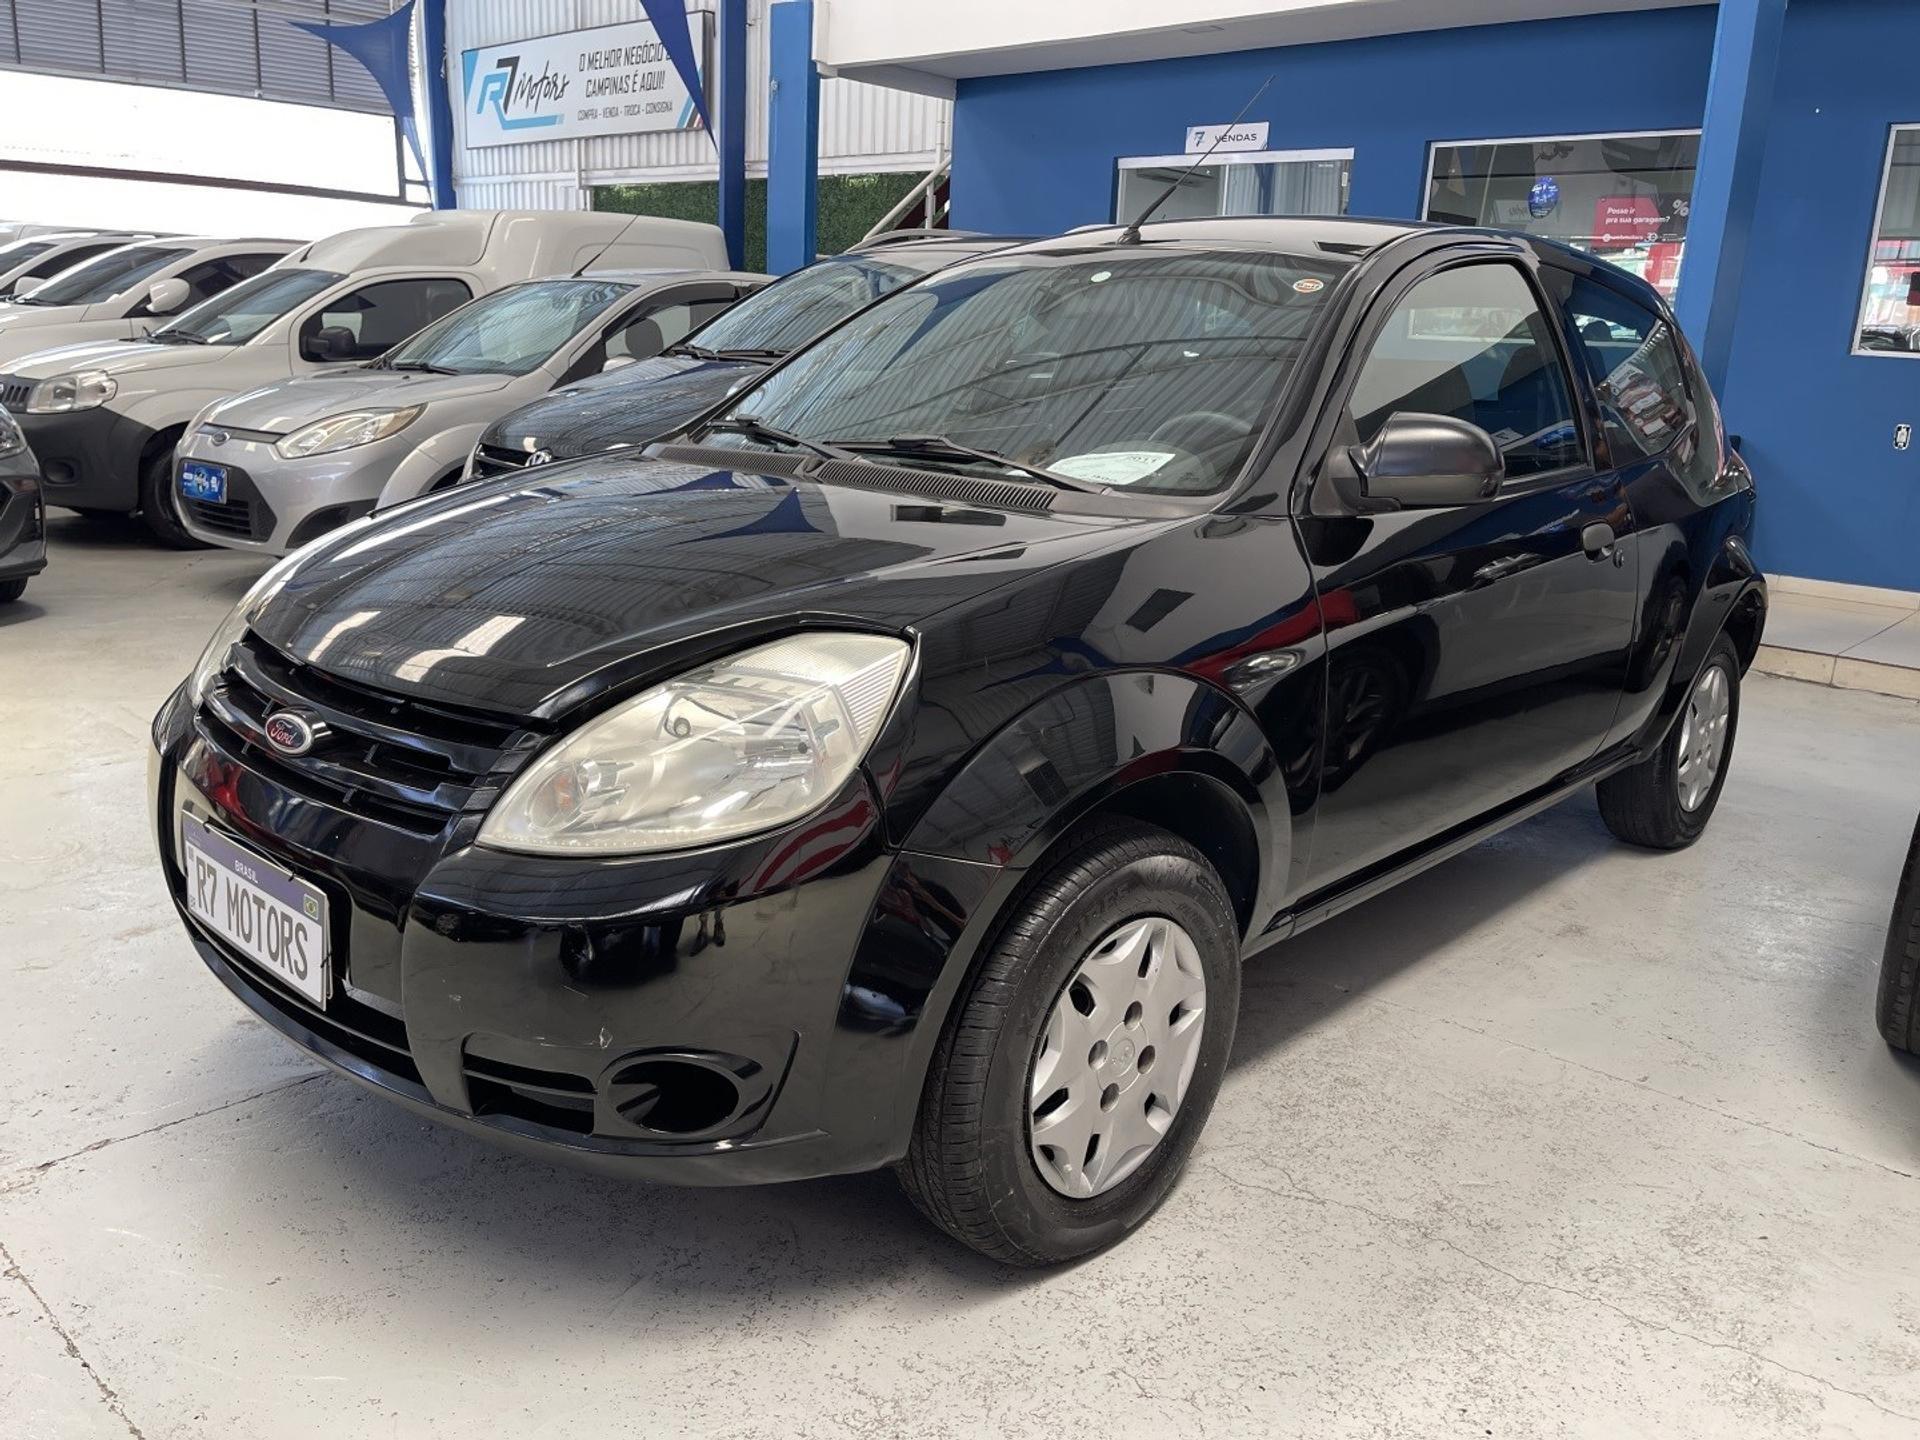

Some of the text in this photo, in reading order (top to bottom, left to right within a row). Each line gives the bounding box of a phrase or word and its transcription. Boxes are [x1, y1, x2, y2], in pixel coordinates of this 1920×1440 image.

[578, 39, 664, 72] O MELHOR NEGÓCIO
[585, 69, 666, 98] CAMPINAS É AQUI!
[577, 108, 598, 121] COMPRA
[624, 104, 641, 116] TROCA
[1214, 133, 1258, 143] VENDAS
[270, 720, 298, 745] Ford
[234, 859, 259, 884] BRASIL
[196, 856, 308, 981] R7 MOTORS
